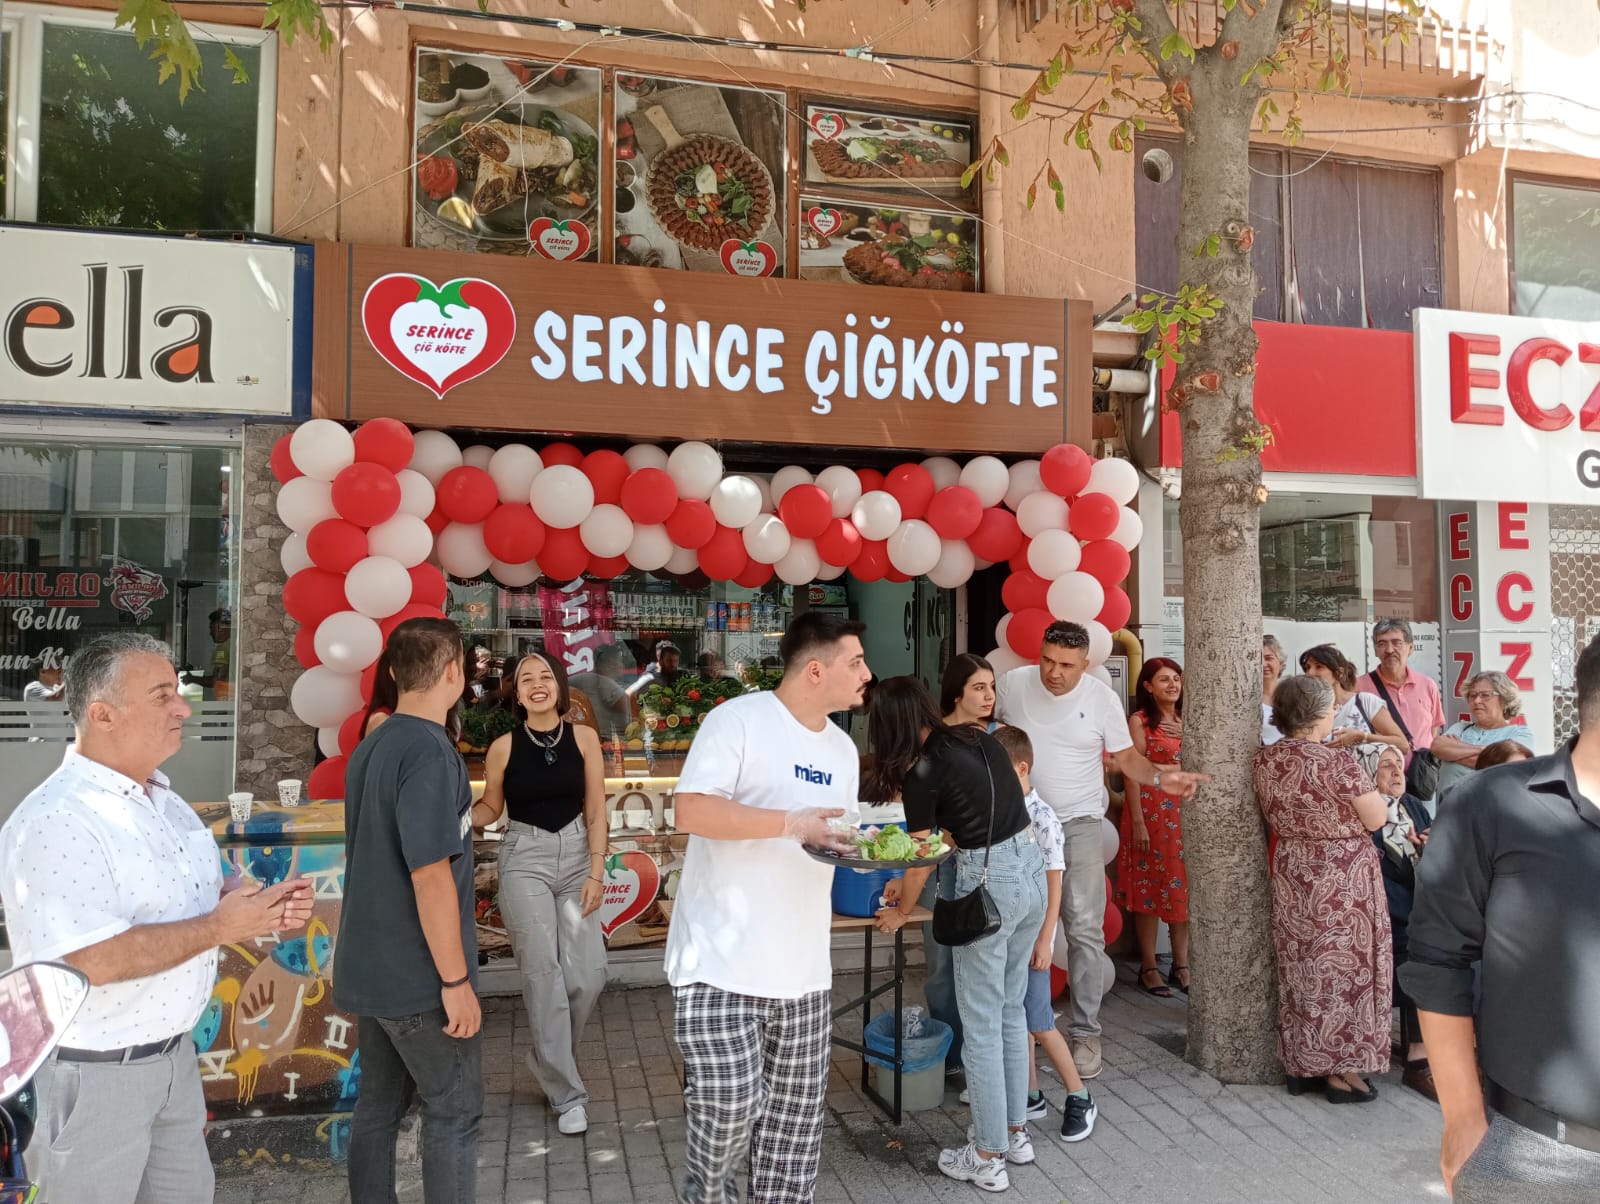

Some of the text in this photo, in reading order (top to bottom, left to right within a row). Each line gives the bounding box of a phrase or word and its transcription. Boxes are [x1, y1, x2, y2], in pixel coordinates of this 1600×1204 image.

[3, 262, 216, 383] ella
[406, 322, 475, 341] SERİNCE
[414, 341, 467, 354] ÇİĞ KÖFTE
[530, 299, 1058, 415] SERİNCE ÇİĞKÖFTE
[1576, 449, 1600, 488] G
[12, 606, 81, 630] Bella
[1449, 512, 1475, 723] ECZ
[1497, 502, 1534, 725] ECZ
[0, 646, 72, 670] an Ku
[794, 763, 832, 786] miav
